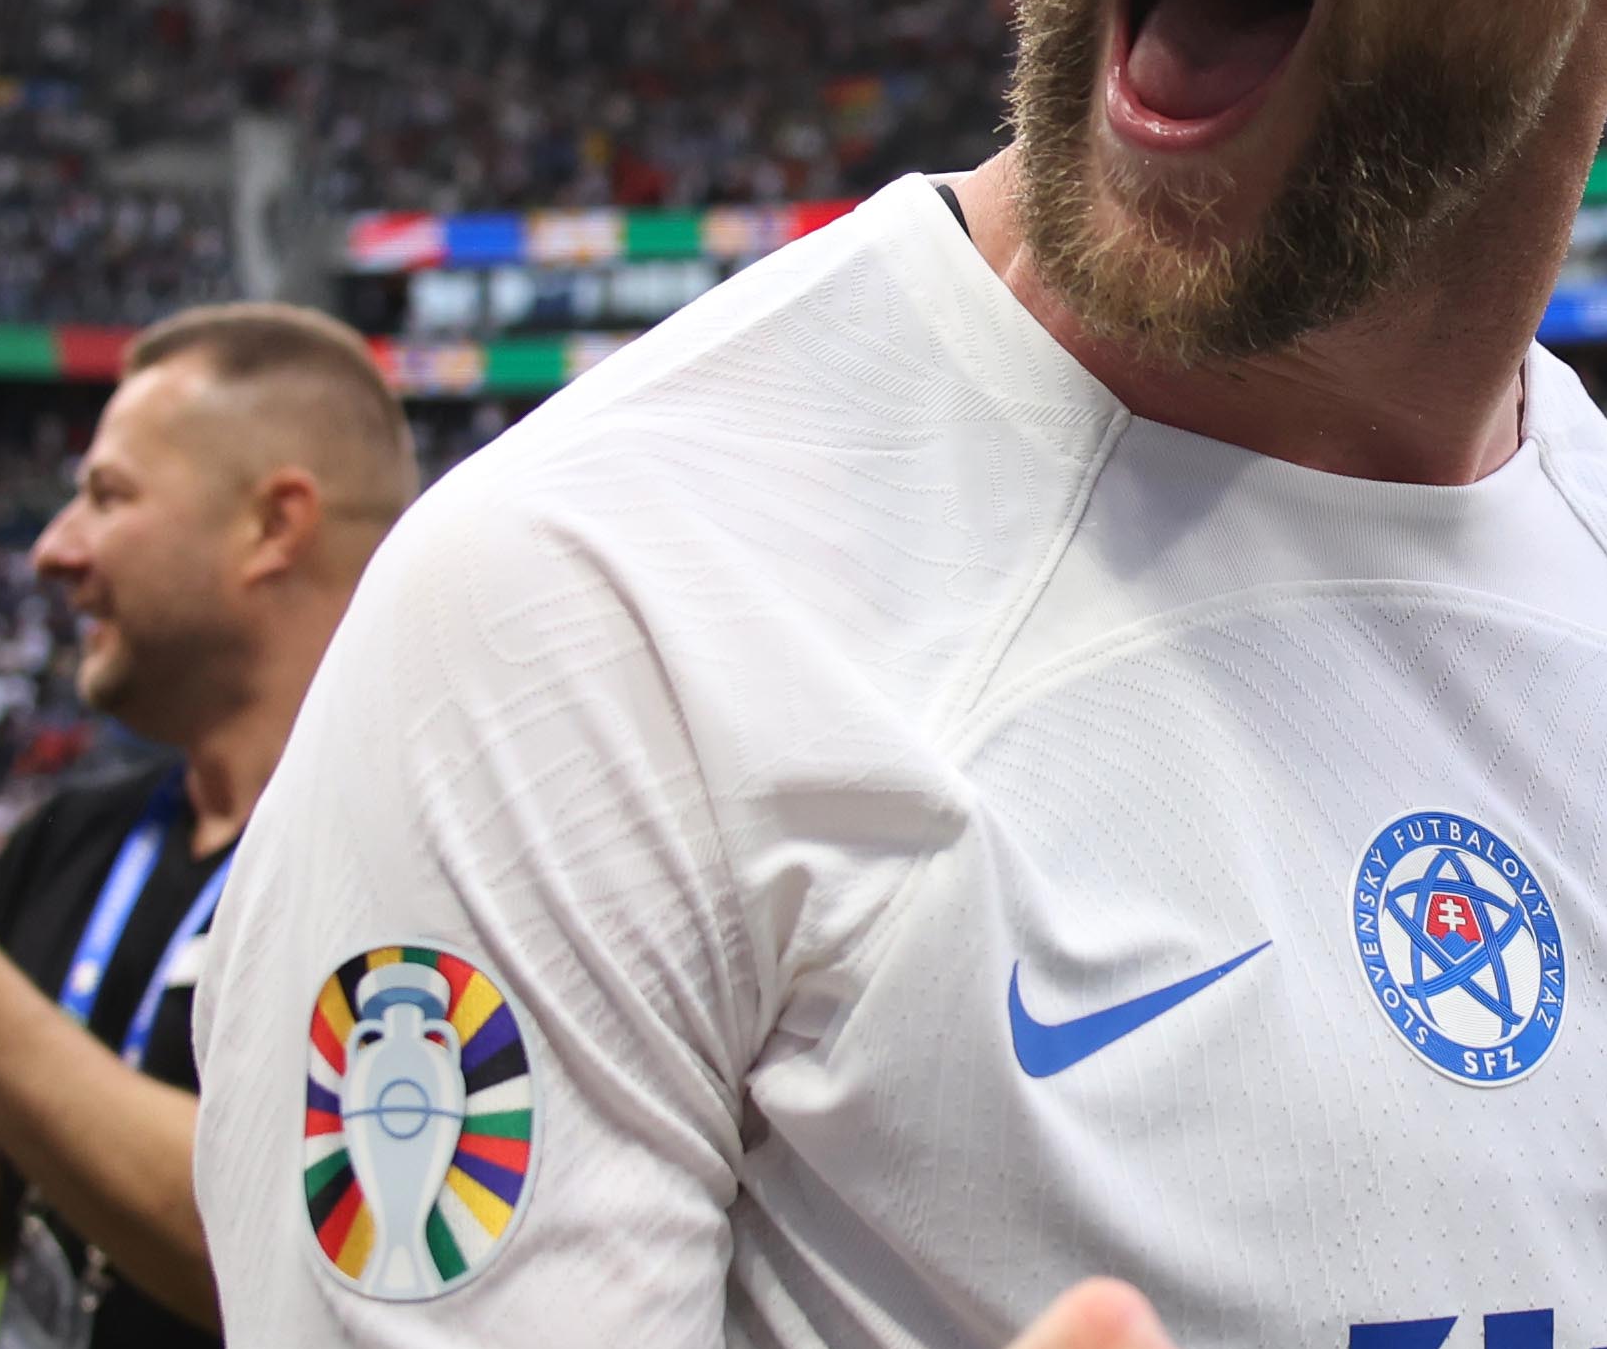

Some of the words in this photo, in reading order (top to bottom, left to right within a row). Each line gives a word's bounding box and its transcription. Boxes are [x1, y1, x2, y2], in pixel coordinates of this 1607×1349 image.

[1392, 818, 1549, 918] FUTBALOVÝ
[1358, 847, 1430, 1046] SLOVENSKÝ
[1536, 941, 1563, 1032] ZVÄZ
[1463, 1045, 1522, 1076] SFZ
